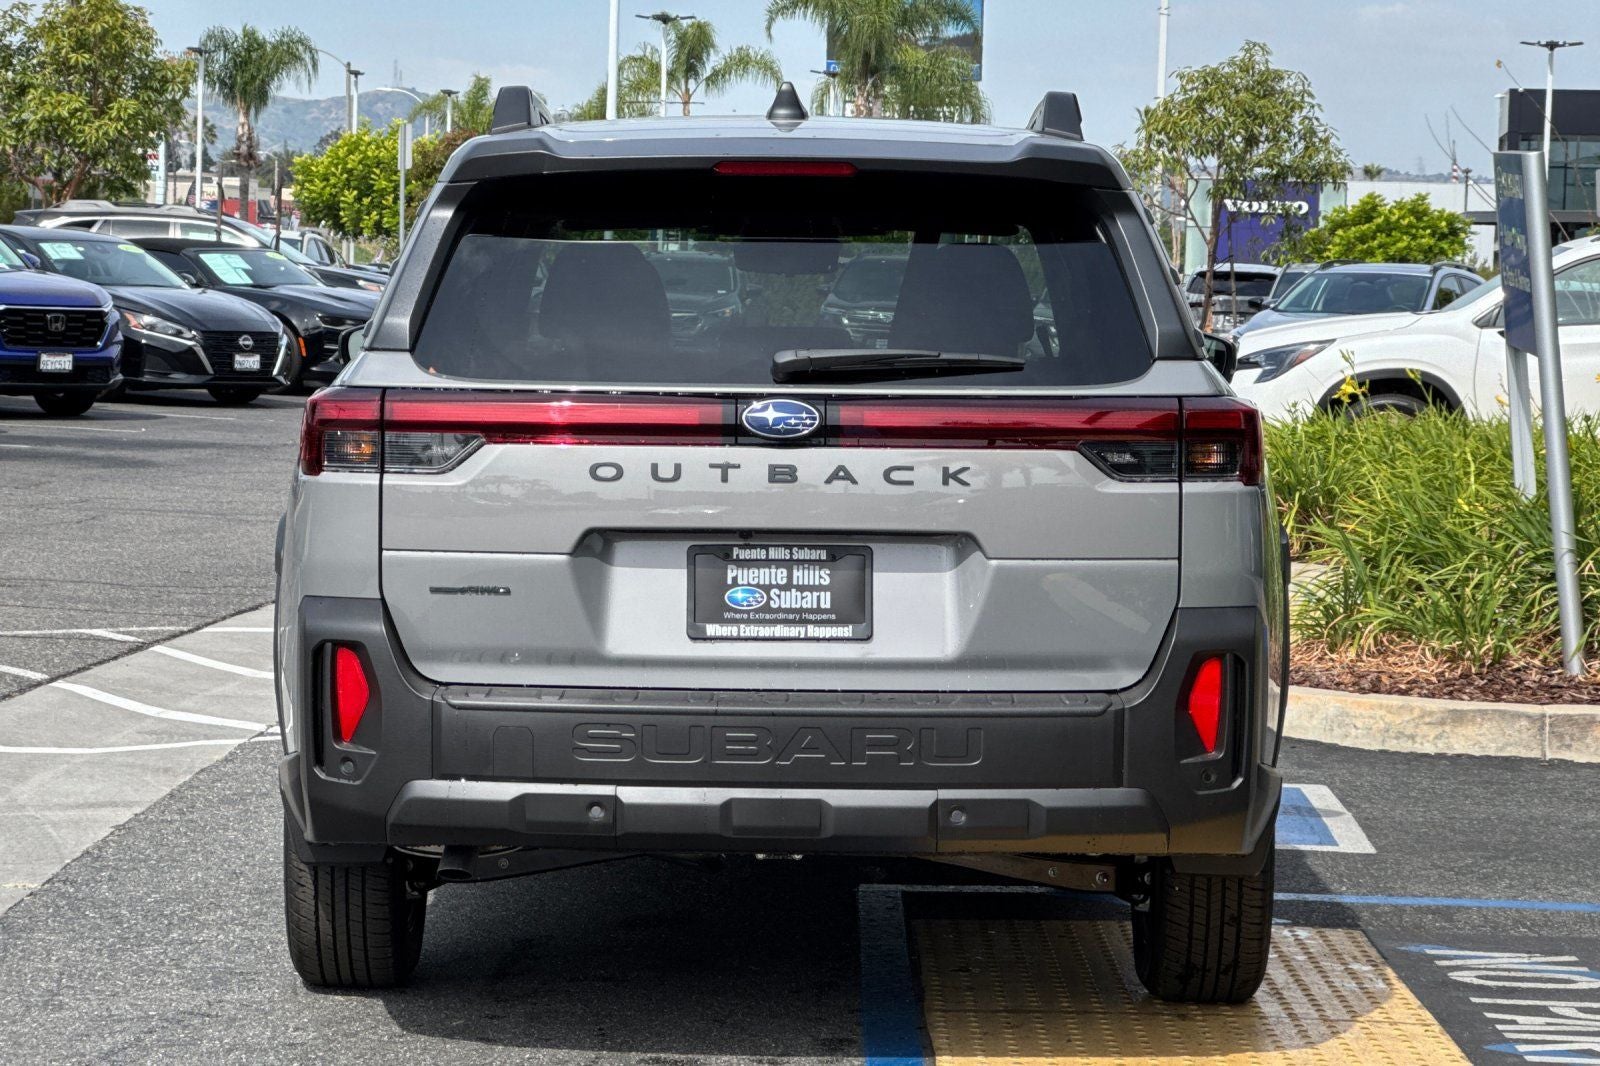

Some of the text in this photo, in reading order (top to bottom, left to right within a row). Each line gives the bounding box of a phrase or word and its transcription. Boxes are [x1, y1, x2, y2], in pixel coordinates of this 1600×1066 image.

[588, 462, 972, 486] OUTBACK
[733, 547, 827, 560] Puente Hills Subaru
[727, 564, 831, 585] Puente Hills
[770, 588, 831, 609] Subaru
[750, 612, 800, 621] Extraordinary
[802, 612, 836, 621] Happens
[706, 624, 853, 638] Where Extraordinary Happens!
[571, 722, 983, 766] SUBARU
